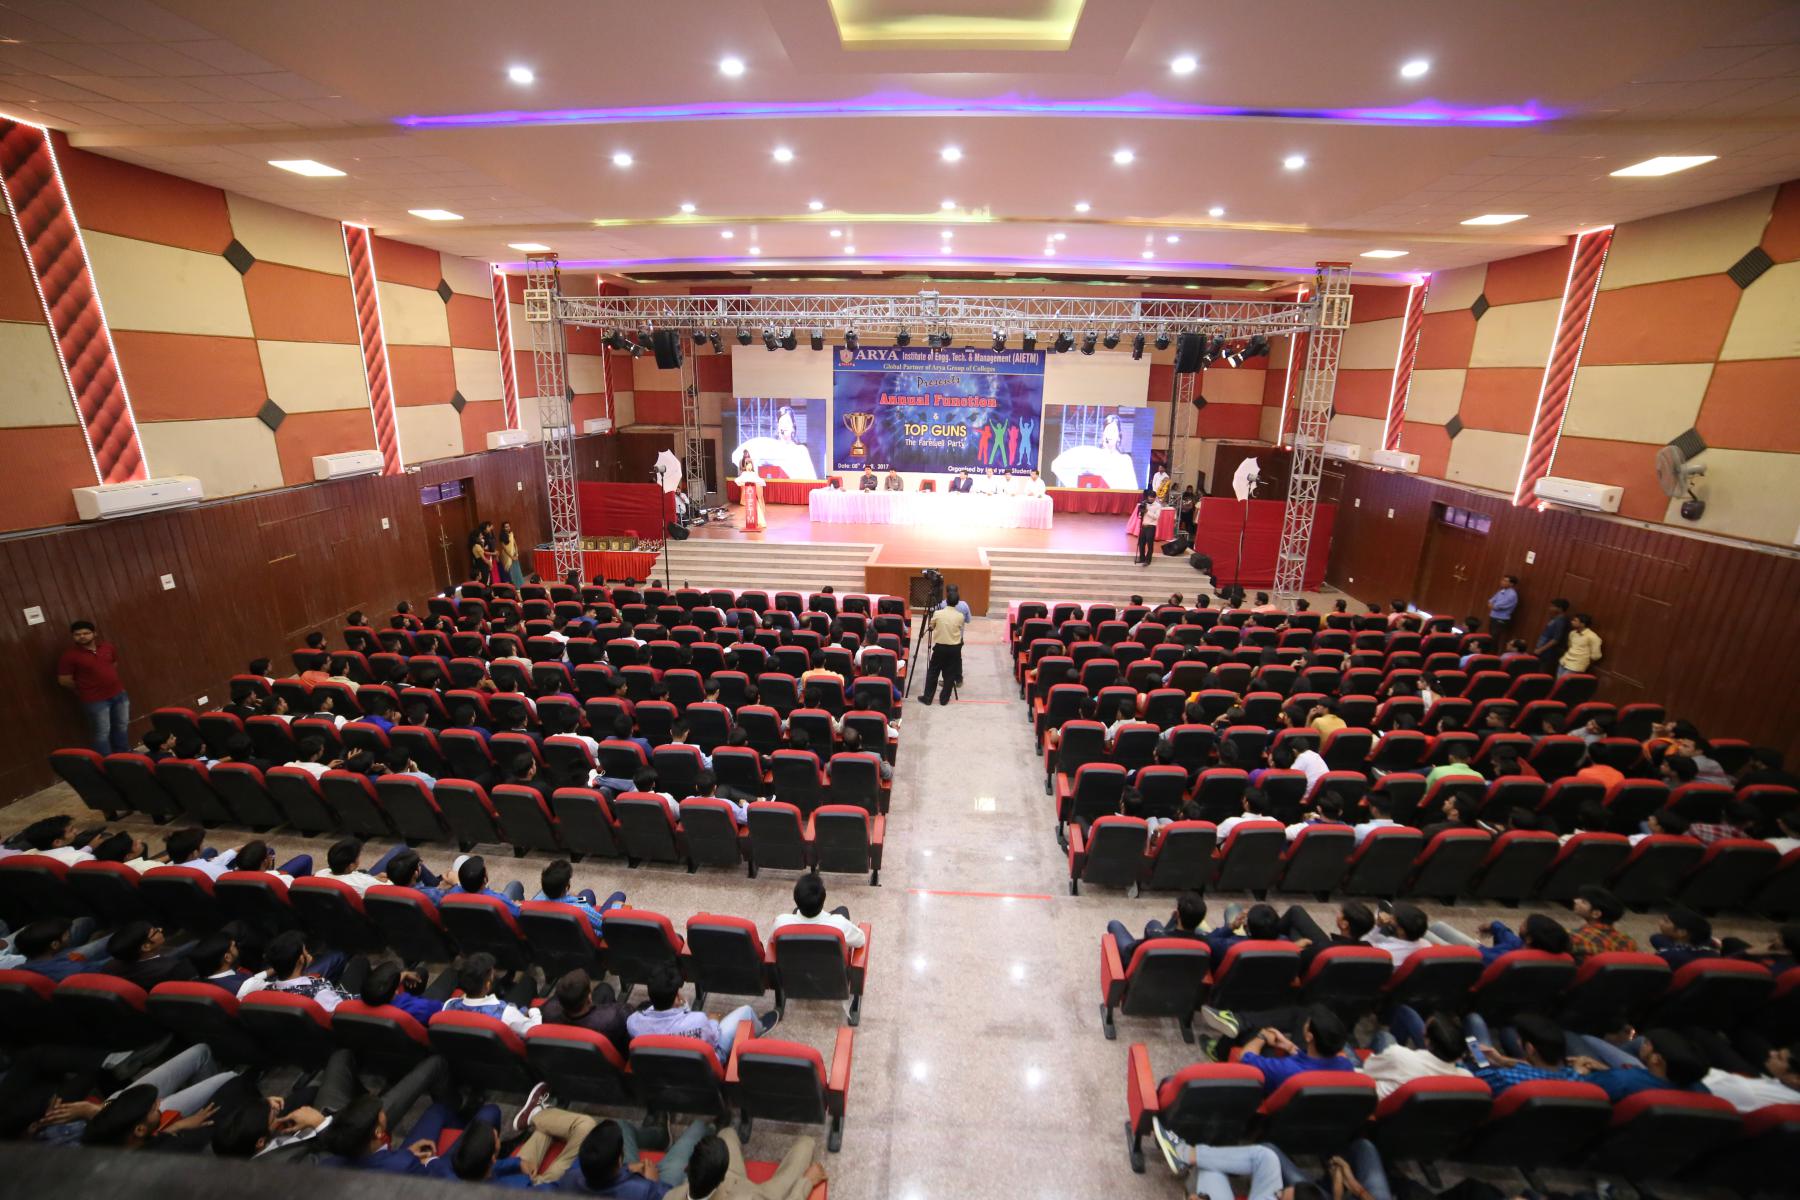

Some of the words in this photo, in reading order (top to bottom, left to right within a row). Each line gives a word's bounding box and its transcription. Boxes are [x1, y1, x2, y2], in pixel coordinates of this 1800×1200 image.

[855, 350, 898, 360] ARYA
[902, 352, 926, 361] Institute
[952, 353, 967, 361] Tech.
[968, 353, 973, 361] &
[974, 353, 1011, 364] Management
[1013, 353, 1039, 365] (AIETM)
[932, 365, 946, 373] Arya
[946, 365, 965, 373] Group
[917, 376, 960, 388] Presents
[879, 392, 930, 406] Annual
[933, 393, 998, 408] Function
[933, 412, 939, 420] &
[904, 424, 928, 436] TOP
[931, 424, 967, 437] GUNS
[947, 439, 965, 449] Party
